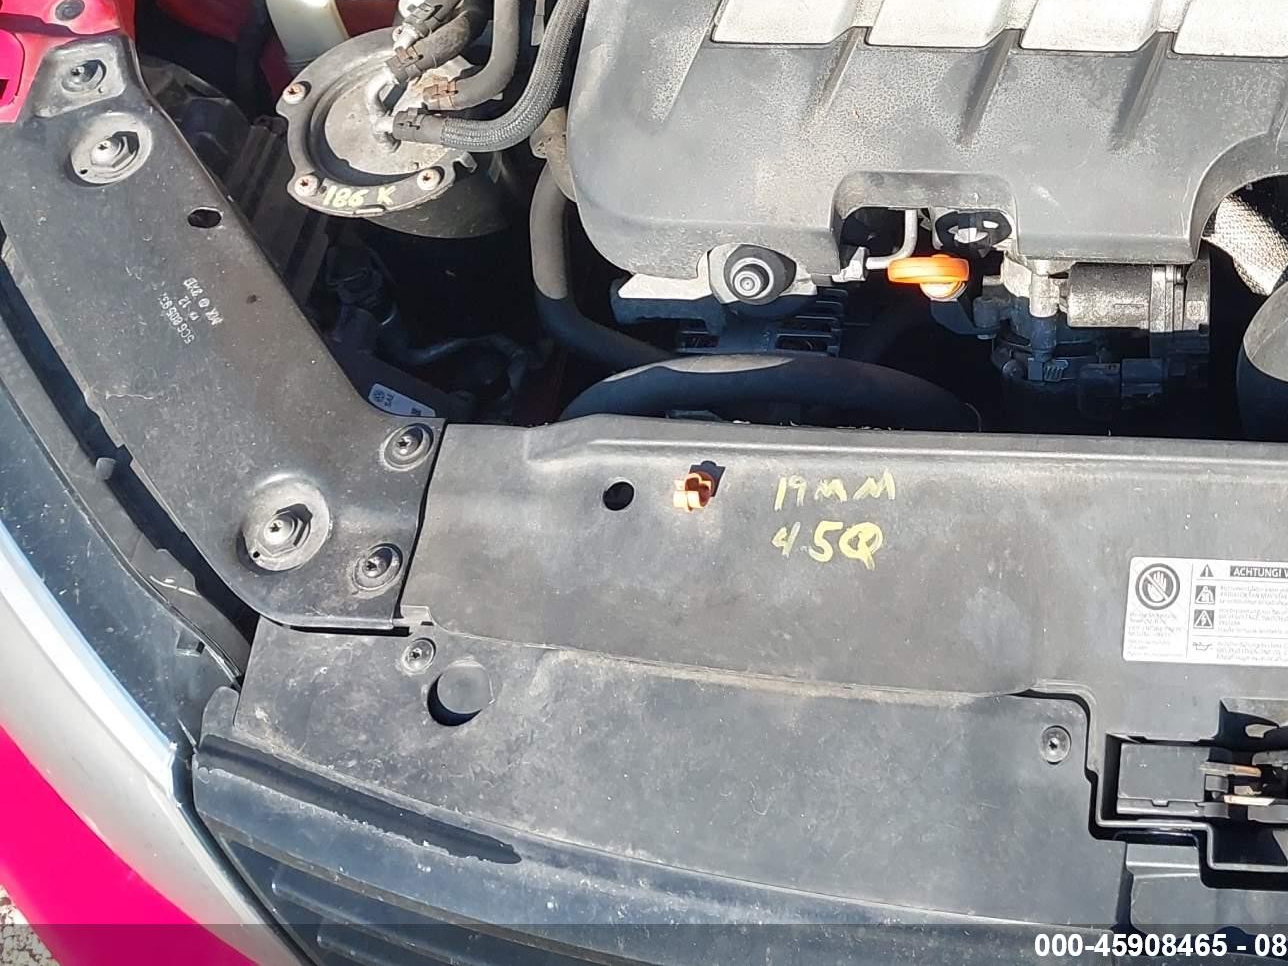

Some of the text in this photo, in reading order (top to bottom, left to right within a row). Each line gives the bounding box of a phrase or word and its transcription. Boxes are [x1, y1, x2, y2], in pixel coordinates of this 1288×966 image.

[322, 185, 397, 208] 186 K
[1233, 567, 1281, 578] ACHTUNG!
